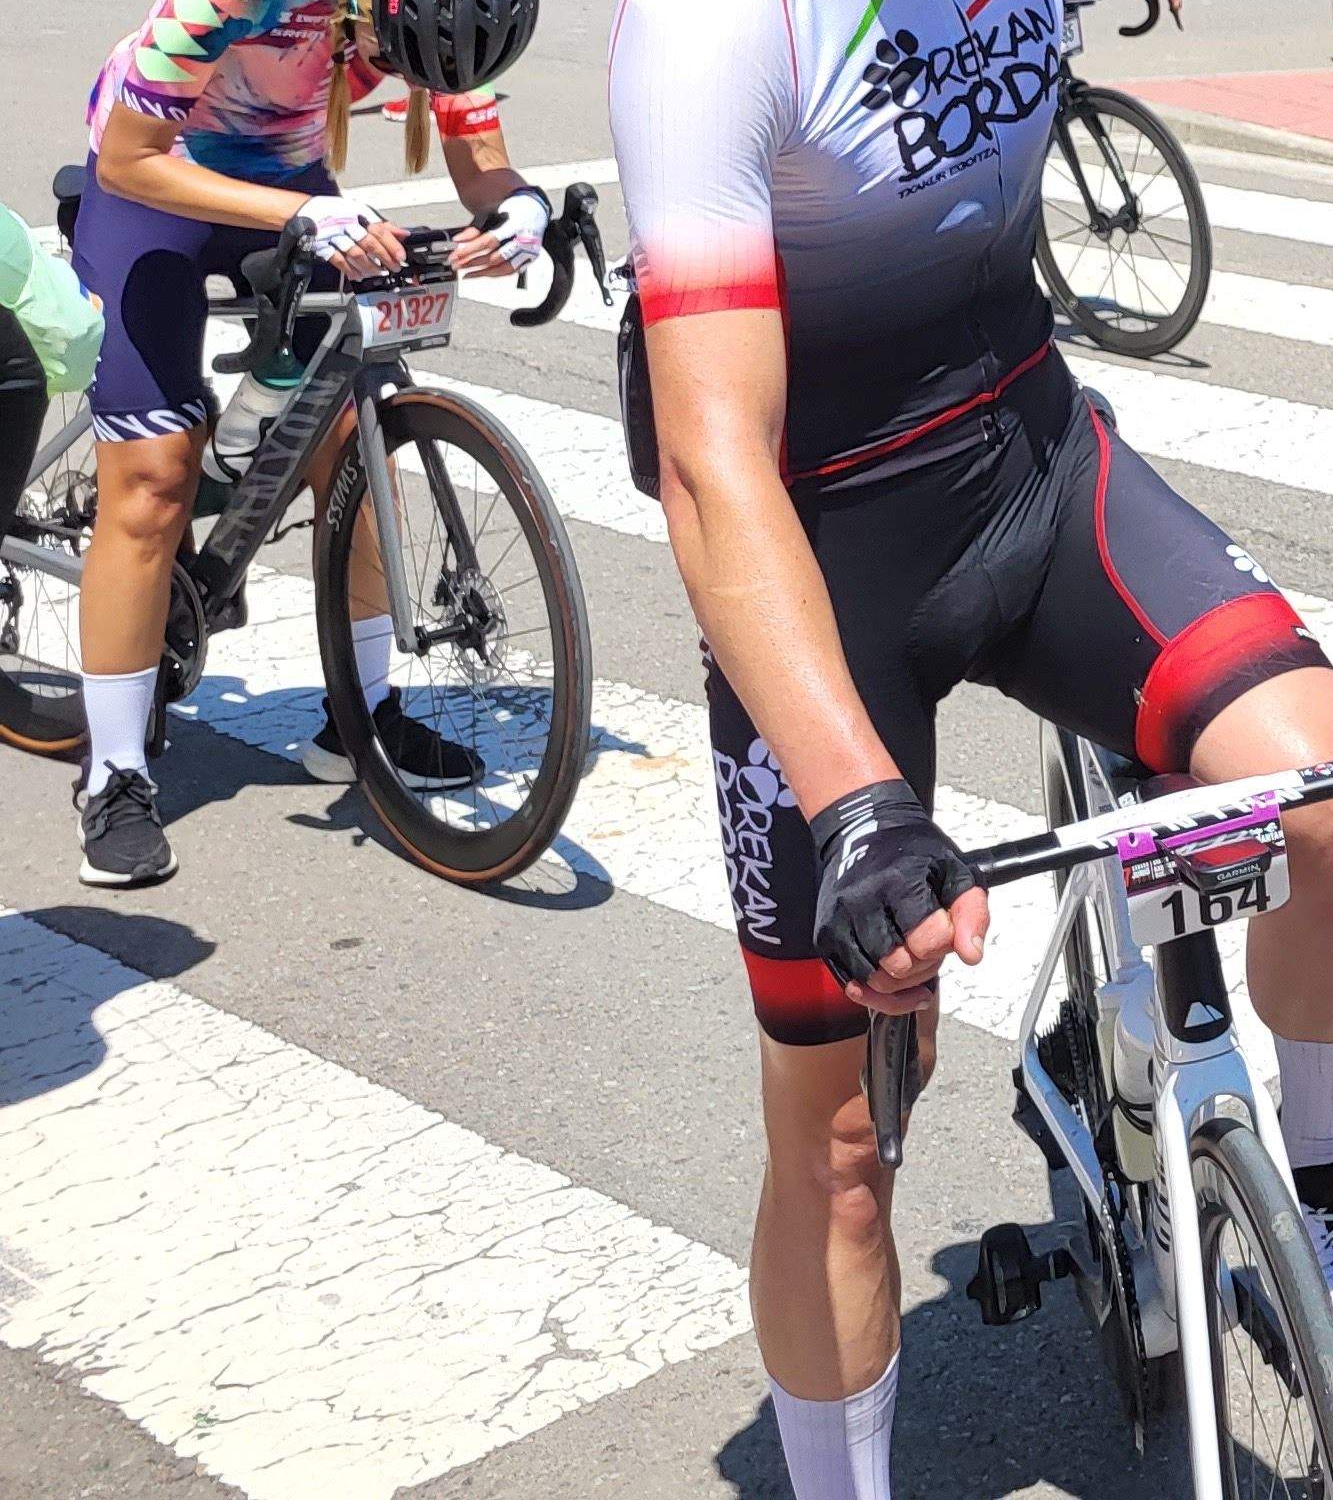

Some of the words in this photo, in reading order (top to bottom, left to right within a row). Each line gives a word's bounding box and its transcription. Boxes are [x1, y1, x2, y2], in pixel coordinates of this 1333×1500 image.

[894, 42, 1060, 183] BORDA
[376, 292, 450, 333] 21327
[1216, 863, 1261, 881] GARMIN
[1162, 874, 1271, 937] 164
